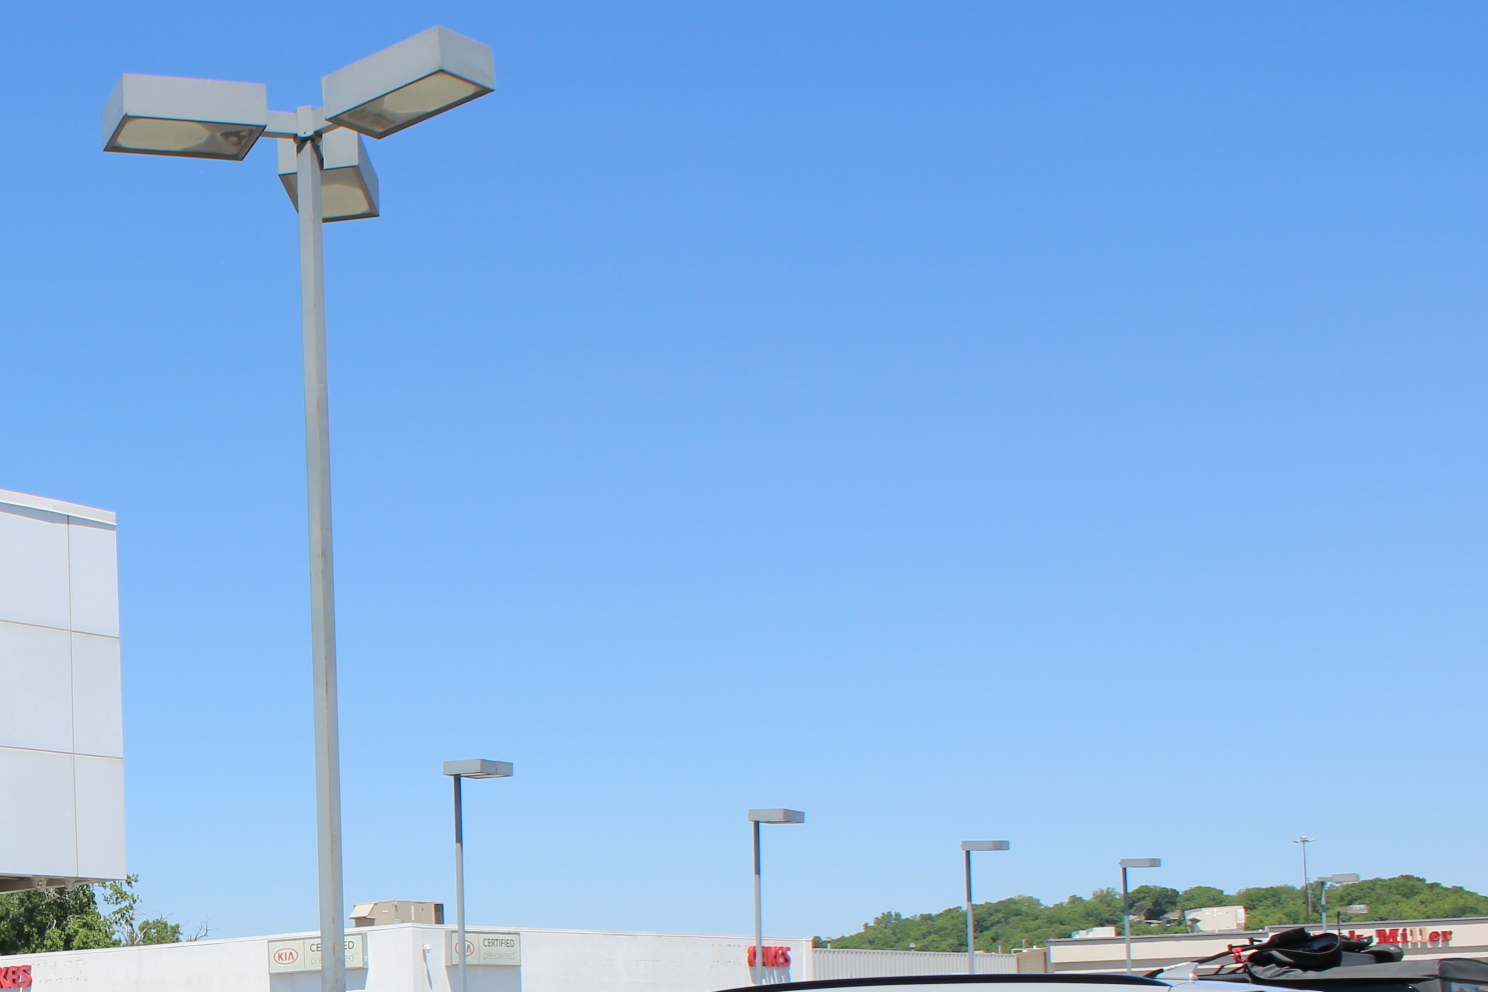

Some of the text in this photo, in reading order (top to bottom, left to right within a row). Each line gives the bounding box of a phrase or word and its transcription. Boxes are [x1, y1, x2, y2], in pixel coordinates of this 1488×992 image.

[1375, 927, 1453, 945] Miller
[482, 938, 515, 948] CERTIFIED
[277, 951, 295, 962] KIA
